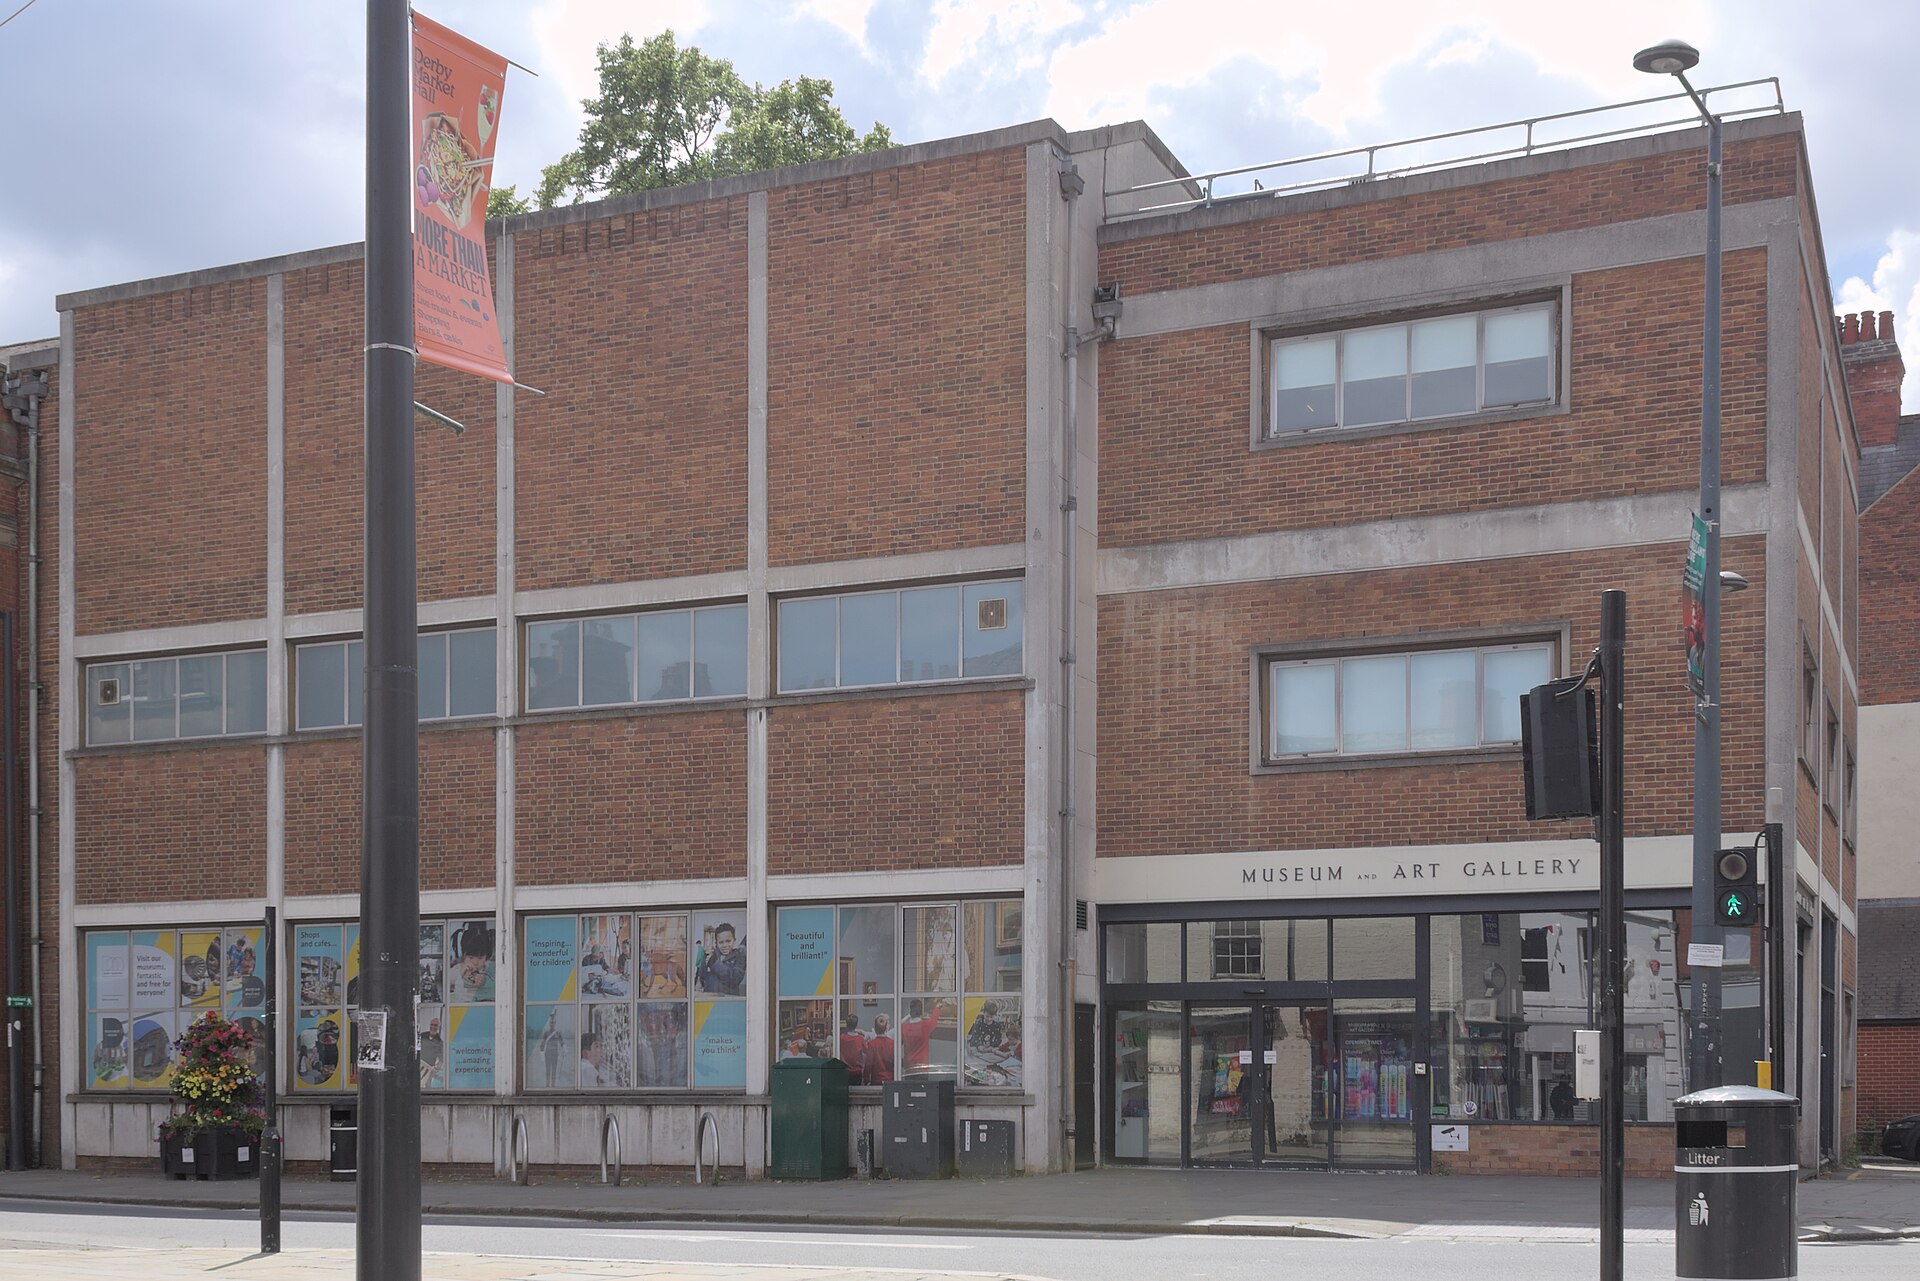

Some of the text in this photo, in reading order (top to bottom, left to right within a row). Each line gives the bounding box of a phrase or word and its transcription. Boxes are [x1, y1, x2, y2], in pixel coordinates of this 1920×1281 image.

[415, 46, 453, 81] Derby
[415, 63, 455, 98] Market
[414, 78, 435, 104] Hall
[415, 208, 485, 276] MORE THAN
[416, 246, 487, 298] A MARKET
[416, 281, 451, 304] Street food
[416, 308, 451, 331] Shopping
[431, 302, 452, 317] music
[452, 310, 459, 320] &
[1242, 865, 1343, 883] MUSEUM
[1393, 863, 1440, 880] ART
[1462, 859, 1581, 877] GALLERY
[301, 931, 320, 939] Shops
[786, 931, 825, 940] "beautiful
[532, 948, 568, 957] wonderful
[800, 941, 815, 950] and
[530, 958, 540, 967] for
[705, 1036, 733, 1044] "makes
[701, 1047, 715, 1056] you
[1688, 1152, 1721, 1165] Litter
